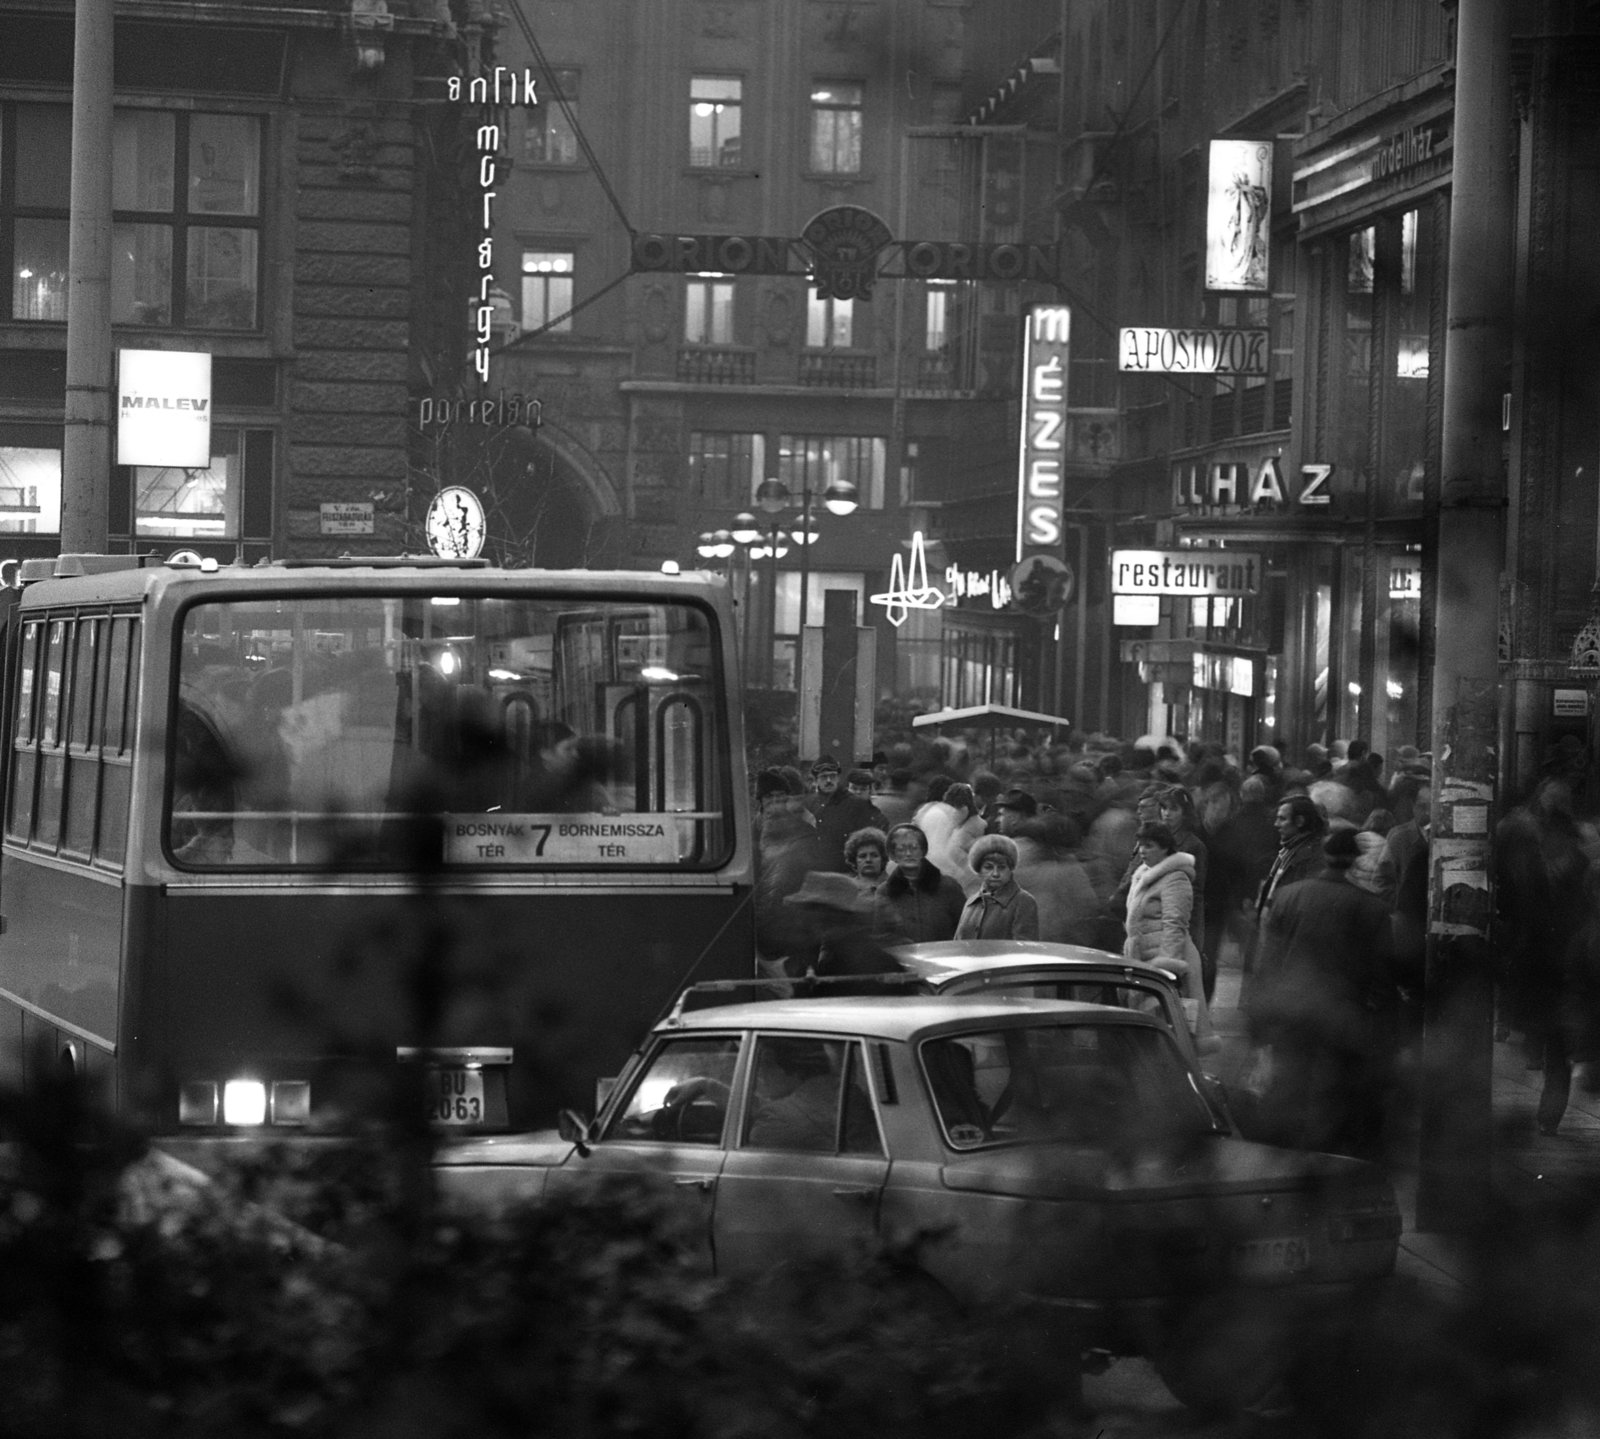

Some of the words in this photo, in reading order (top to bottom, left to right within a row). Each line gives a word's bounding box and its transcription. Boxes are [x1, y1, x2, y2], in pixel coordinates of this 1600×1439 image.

[447, 66, 538, 105] antik
[634, 234, 788, 272] ORION
[908, 241, 1057, 279] ORION
[1123, 329, 1265, 373] APOSTOLOK
[1118, 556, 1256, 590] restaurant
[456, 821, 525, 837] BOSNYÁK
[531, 823, 553, 857] 7
[559, 823, 665, 837] BORNEMISSZA
[476, 842, 505, 858] TÉR
[598, 842, 626, 858] TÉR
